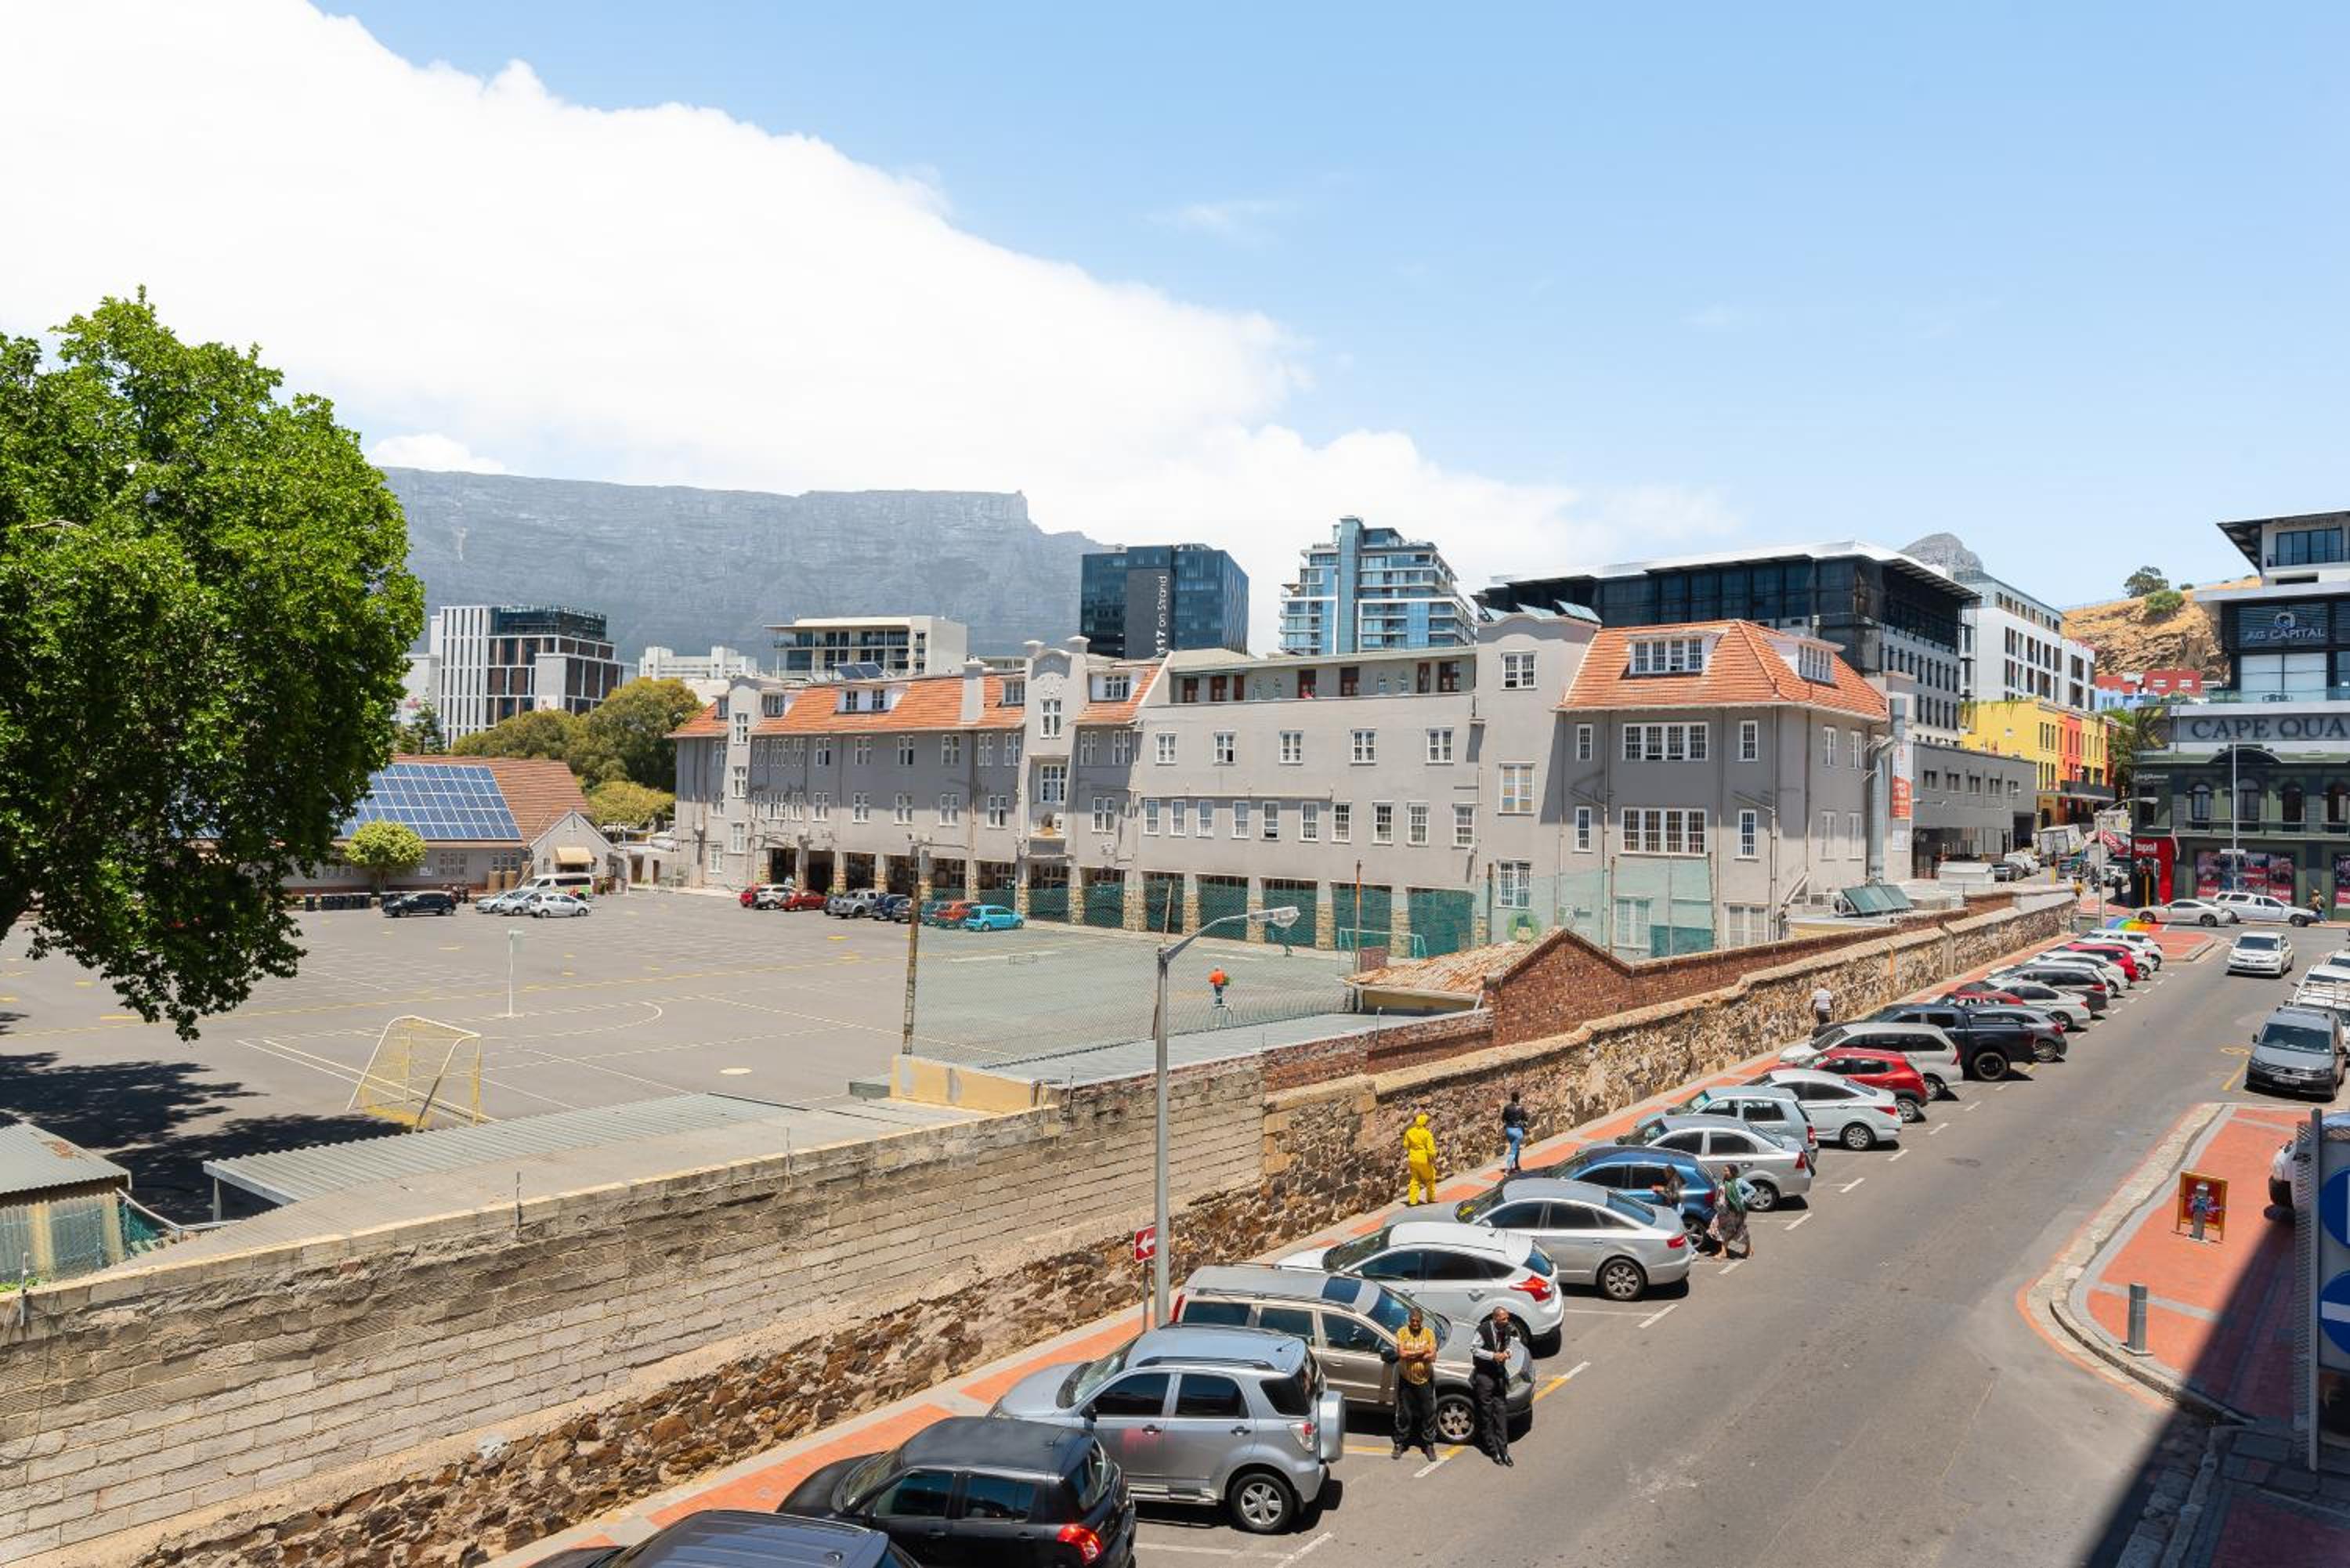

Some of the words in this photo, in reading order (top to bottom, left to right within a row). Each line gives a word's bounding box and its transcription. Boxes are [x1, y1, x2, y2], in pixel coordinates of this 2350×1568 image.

[1158, 576, 1167, 610] Strand
[1159, 614, 1166, 627] on
[2270, 627, 2326, 640] CAPITAL
[2191, 718, 2270, 739] CAPE
[2278, 717, 2347, 738] QUA
